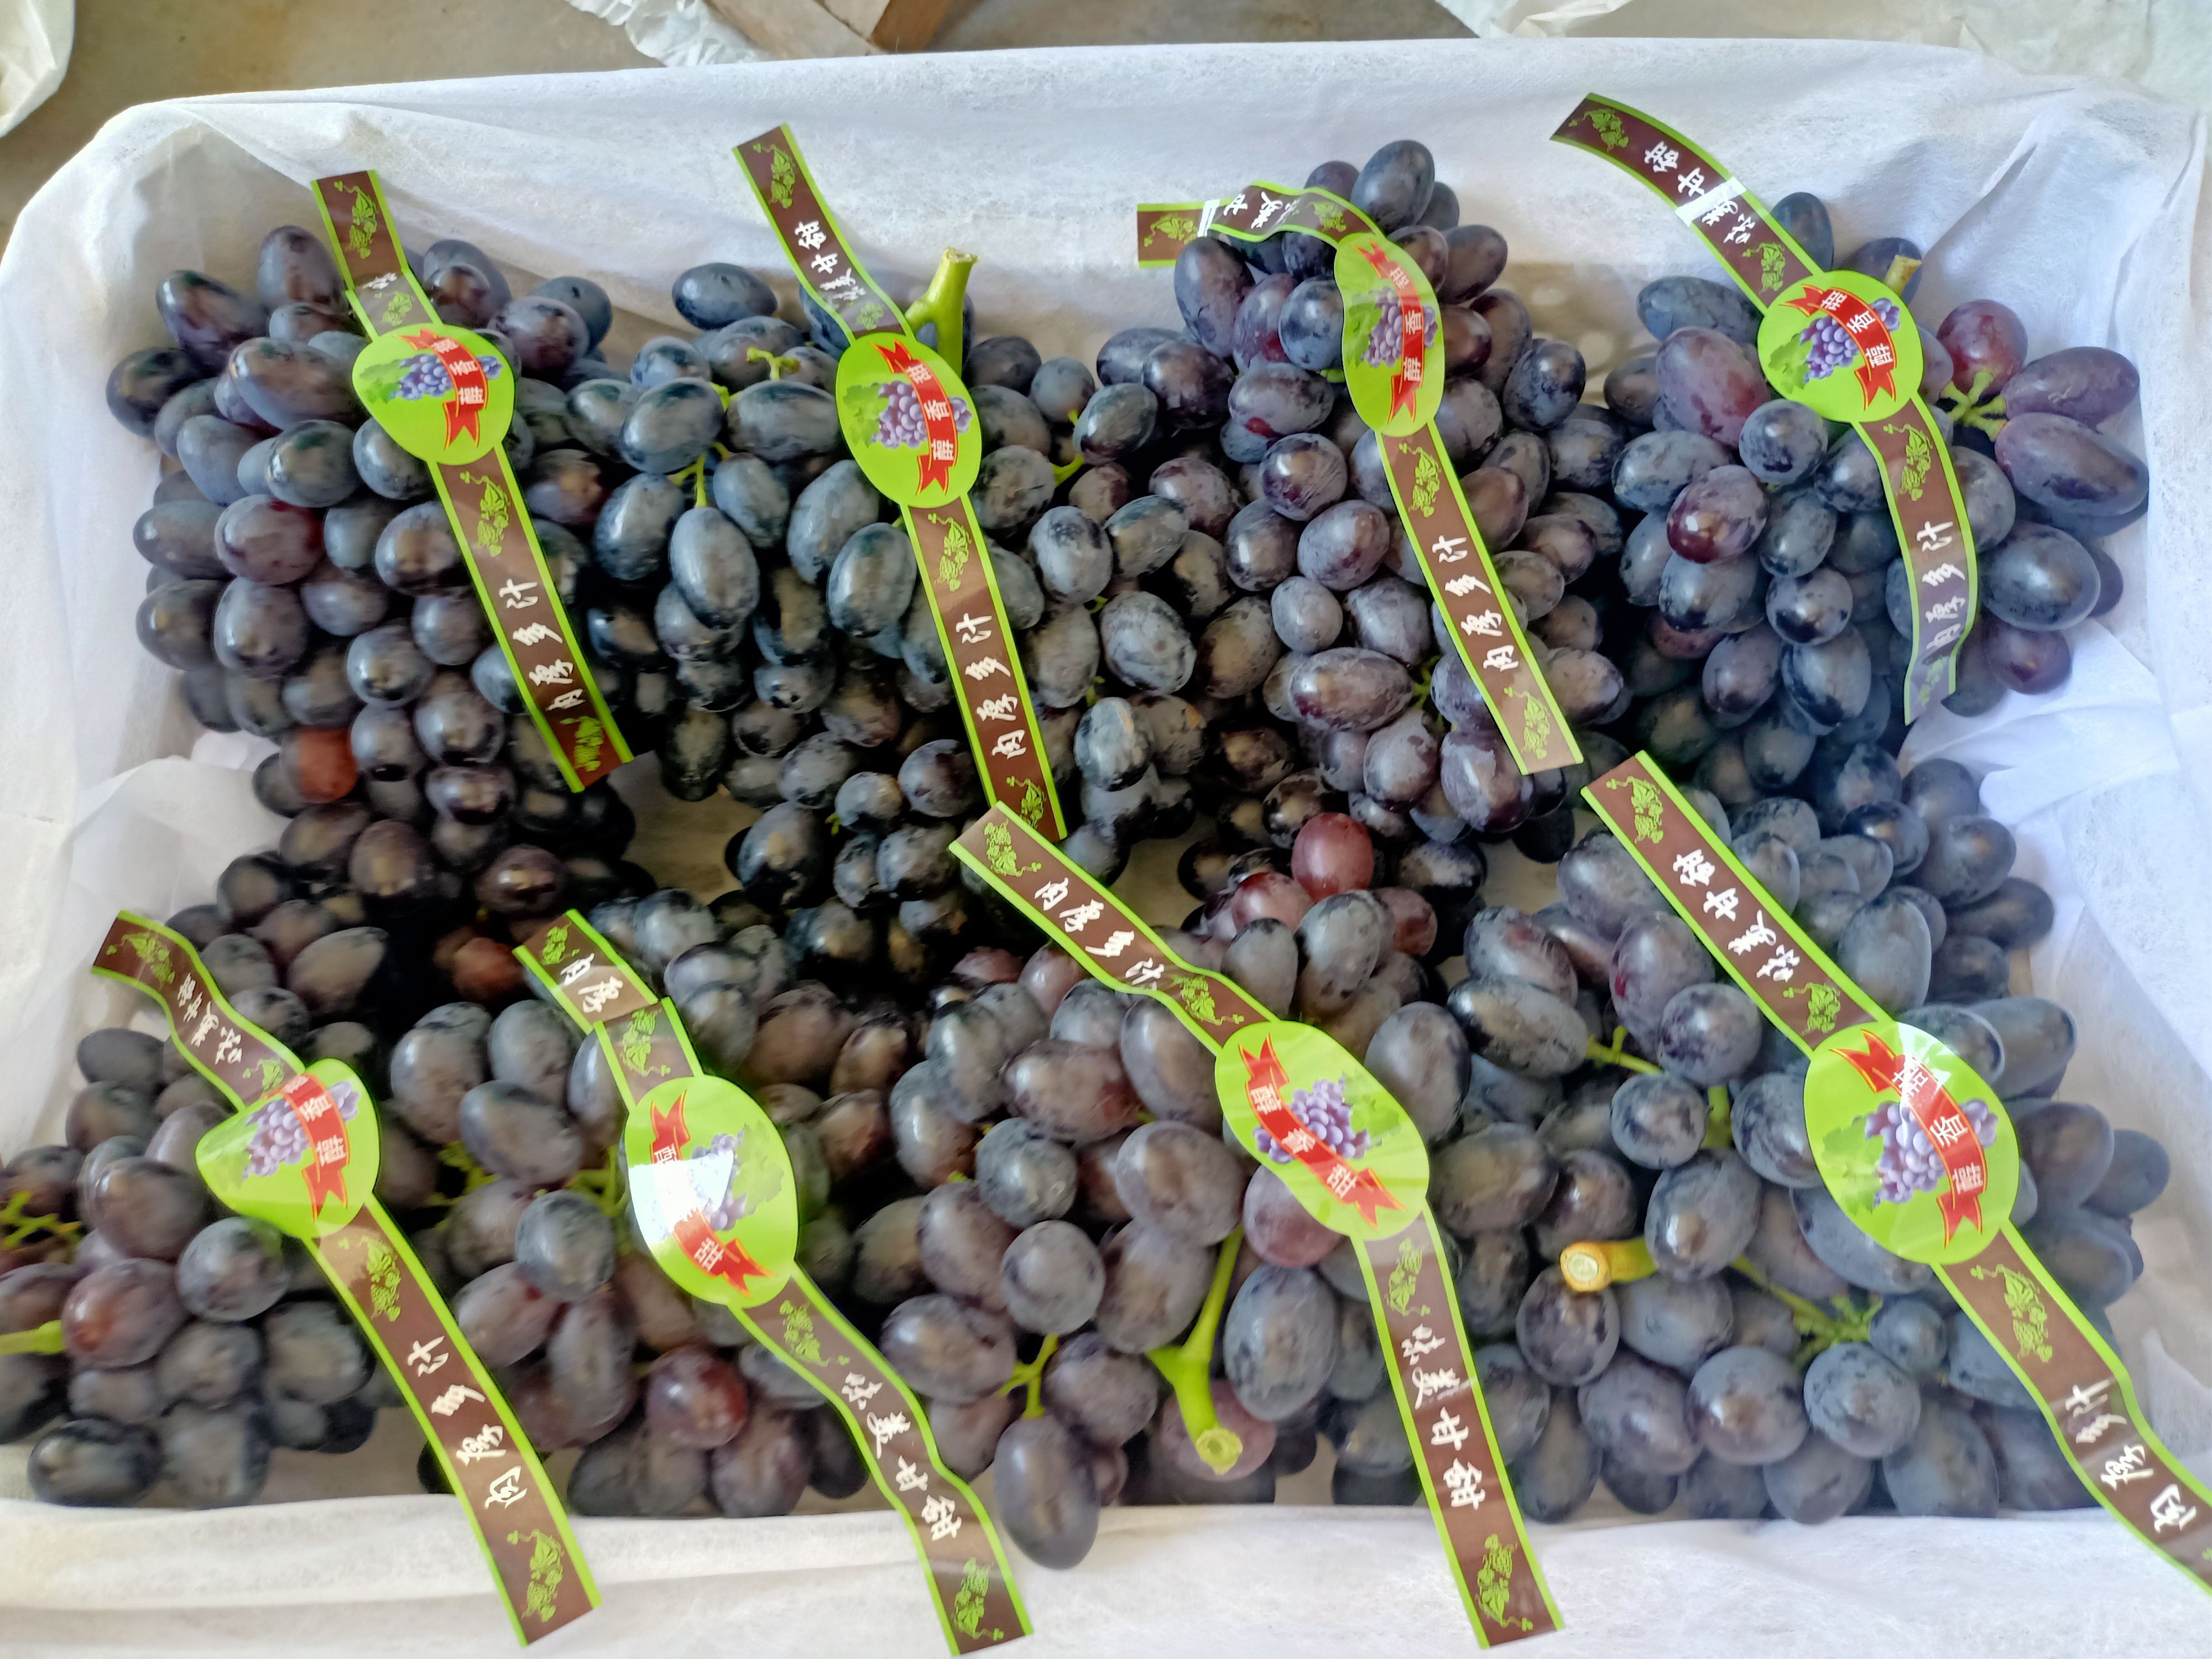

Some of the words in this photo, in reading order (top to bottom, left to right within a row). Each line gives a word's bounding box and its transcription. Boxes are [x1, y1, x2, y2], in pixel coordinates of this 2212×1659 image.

[1820, 289, 1892, 367] 醇香甜
[905, 363, 952, 462] 醇香甜
[1432, 535, 1521, 671] 肉厚多汁
[956, 612, 1027, 760] 肉厚多汁
[1672, 848, 1802, 983] 味美甘甜
[1248, 1083, 1358, 1201] 醇香甜
[406, 1335, 529, 1509] 肉厚多汁
[844, 1373, 962, 1541] 味美甘甜
[1400, 1324, 1486, 1509] 味美甘甜
